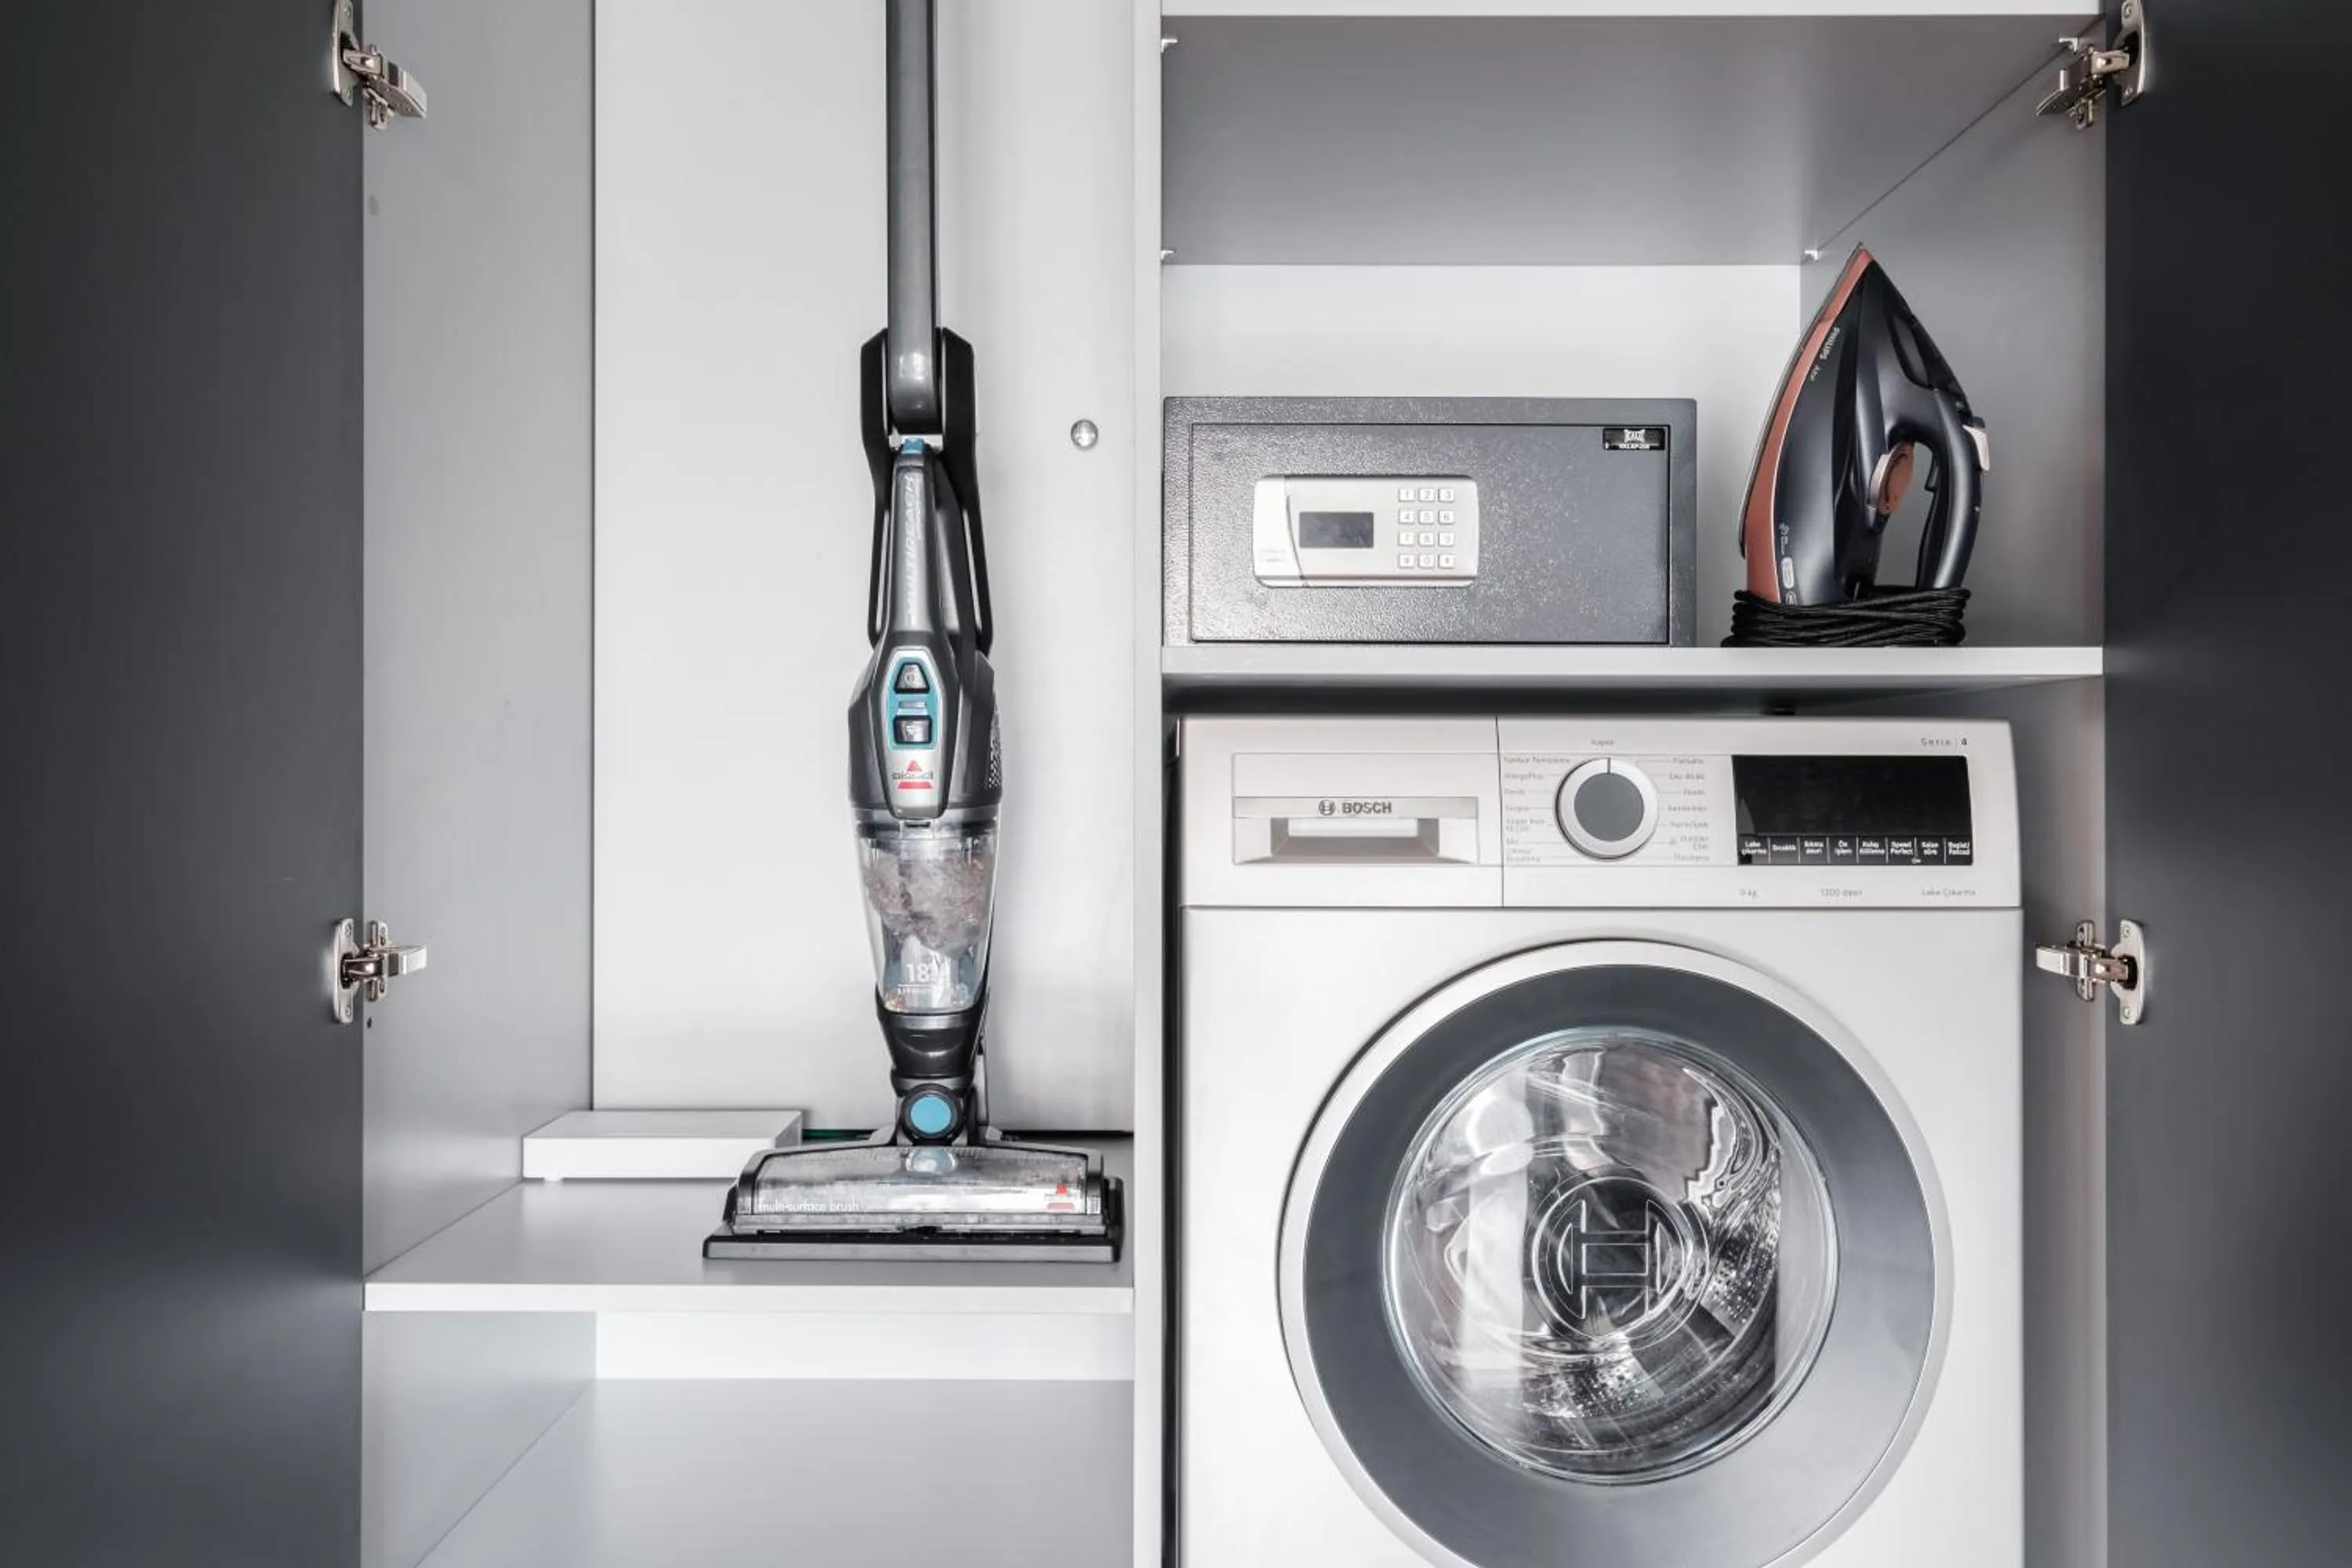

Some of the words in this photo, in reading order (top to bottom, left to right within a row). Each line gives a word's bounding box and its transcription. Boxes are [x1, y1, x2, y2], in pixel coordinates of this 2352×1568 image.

[1820, 327, 1840, 359] PHILIPS
[1341, 801, 1392, 815] BOSCH
[829, 1197, 860, 1212] brush
